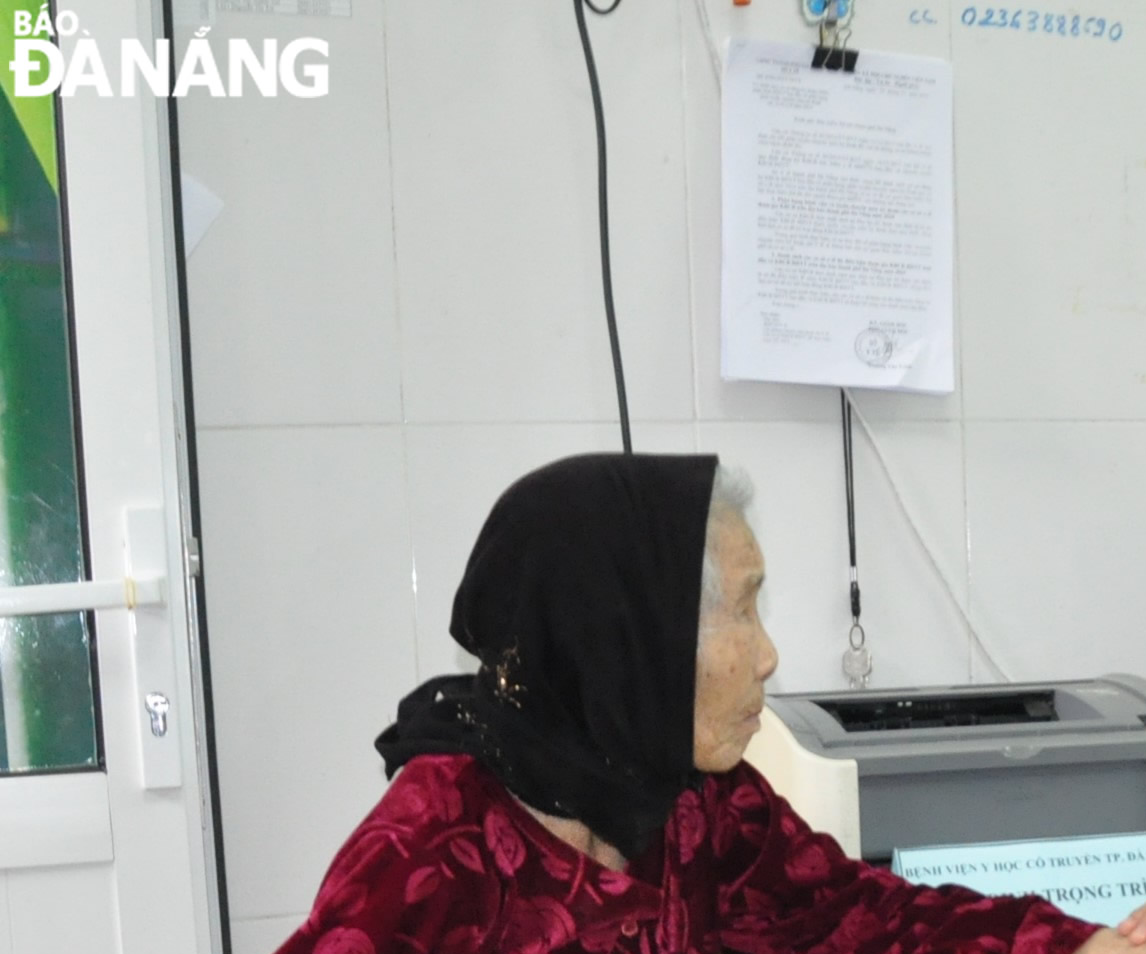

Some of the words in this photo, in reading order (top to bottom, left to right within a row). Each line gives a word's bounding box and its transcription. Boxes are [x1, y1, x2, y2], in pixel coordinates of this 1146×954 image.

[905, 865, 942, 879] BỆNH
[945, 862, 978, 877] VIỆN
[979, 861, 990, 872] Y
[993, 858, 1022, 874] HỌC
[1105, 852, 1125, 864] TP.
[1127, 848, 1145, 863] ĐÀ
[1041, 884, 1113, 904] TRỌNG
